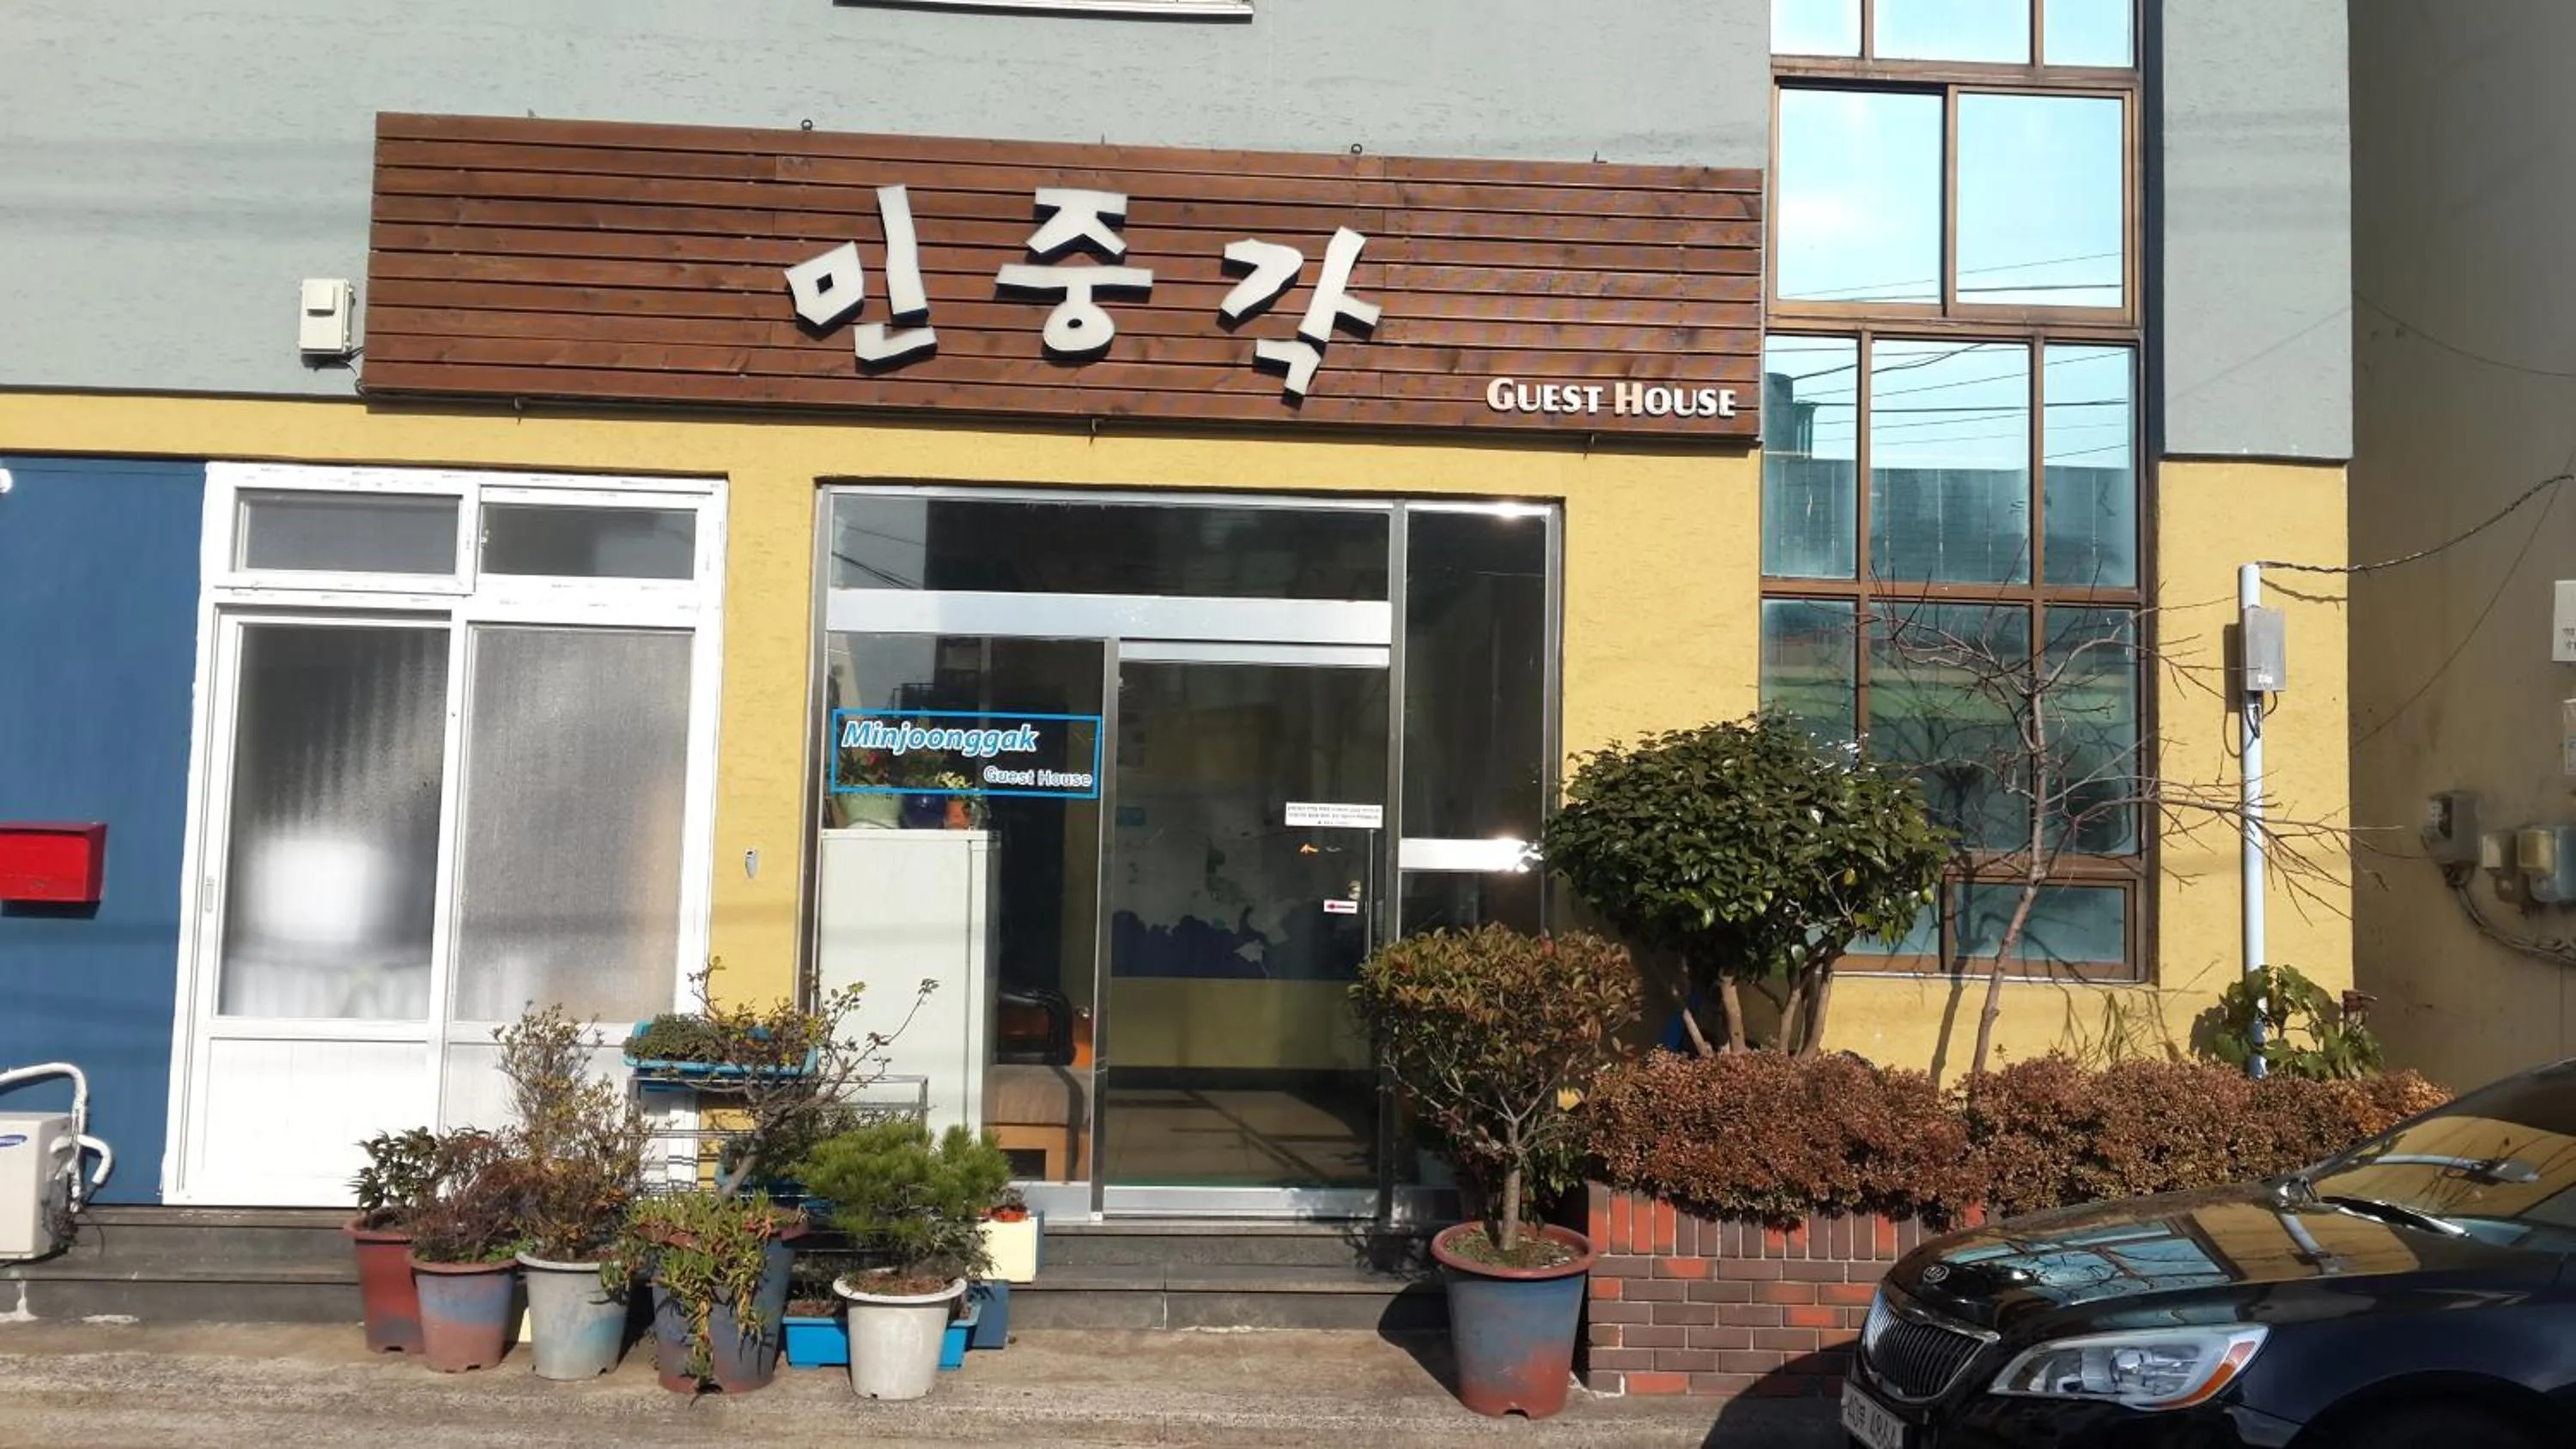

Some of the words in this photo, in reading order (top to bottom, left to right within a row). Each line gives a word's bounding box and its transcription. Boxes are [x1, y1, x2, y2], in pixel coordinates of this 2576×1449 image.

[783, 184, 1382, 400] 민중각
[1486, 377, 1603, 412] GUEST
[1614, 382, 1737, 417] HOUSE
[841, 721, 1040, 756] Minjoonggak
[983, 765, 1035, 785] Guest
[1036, 769, 1093, 787] House
